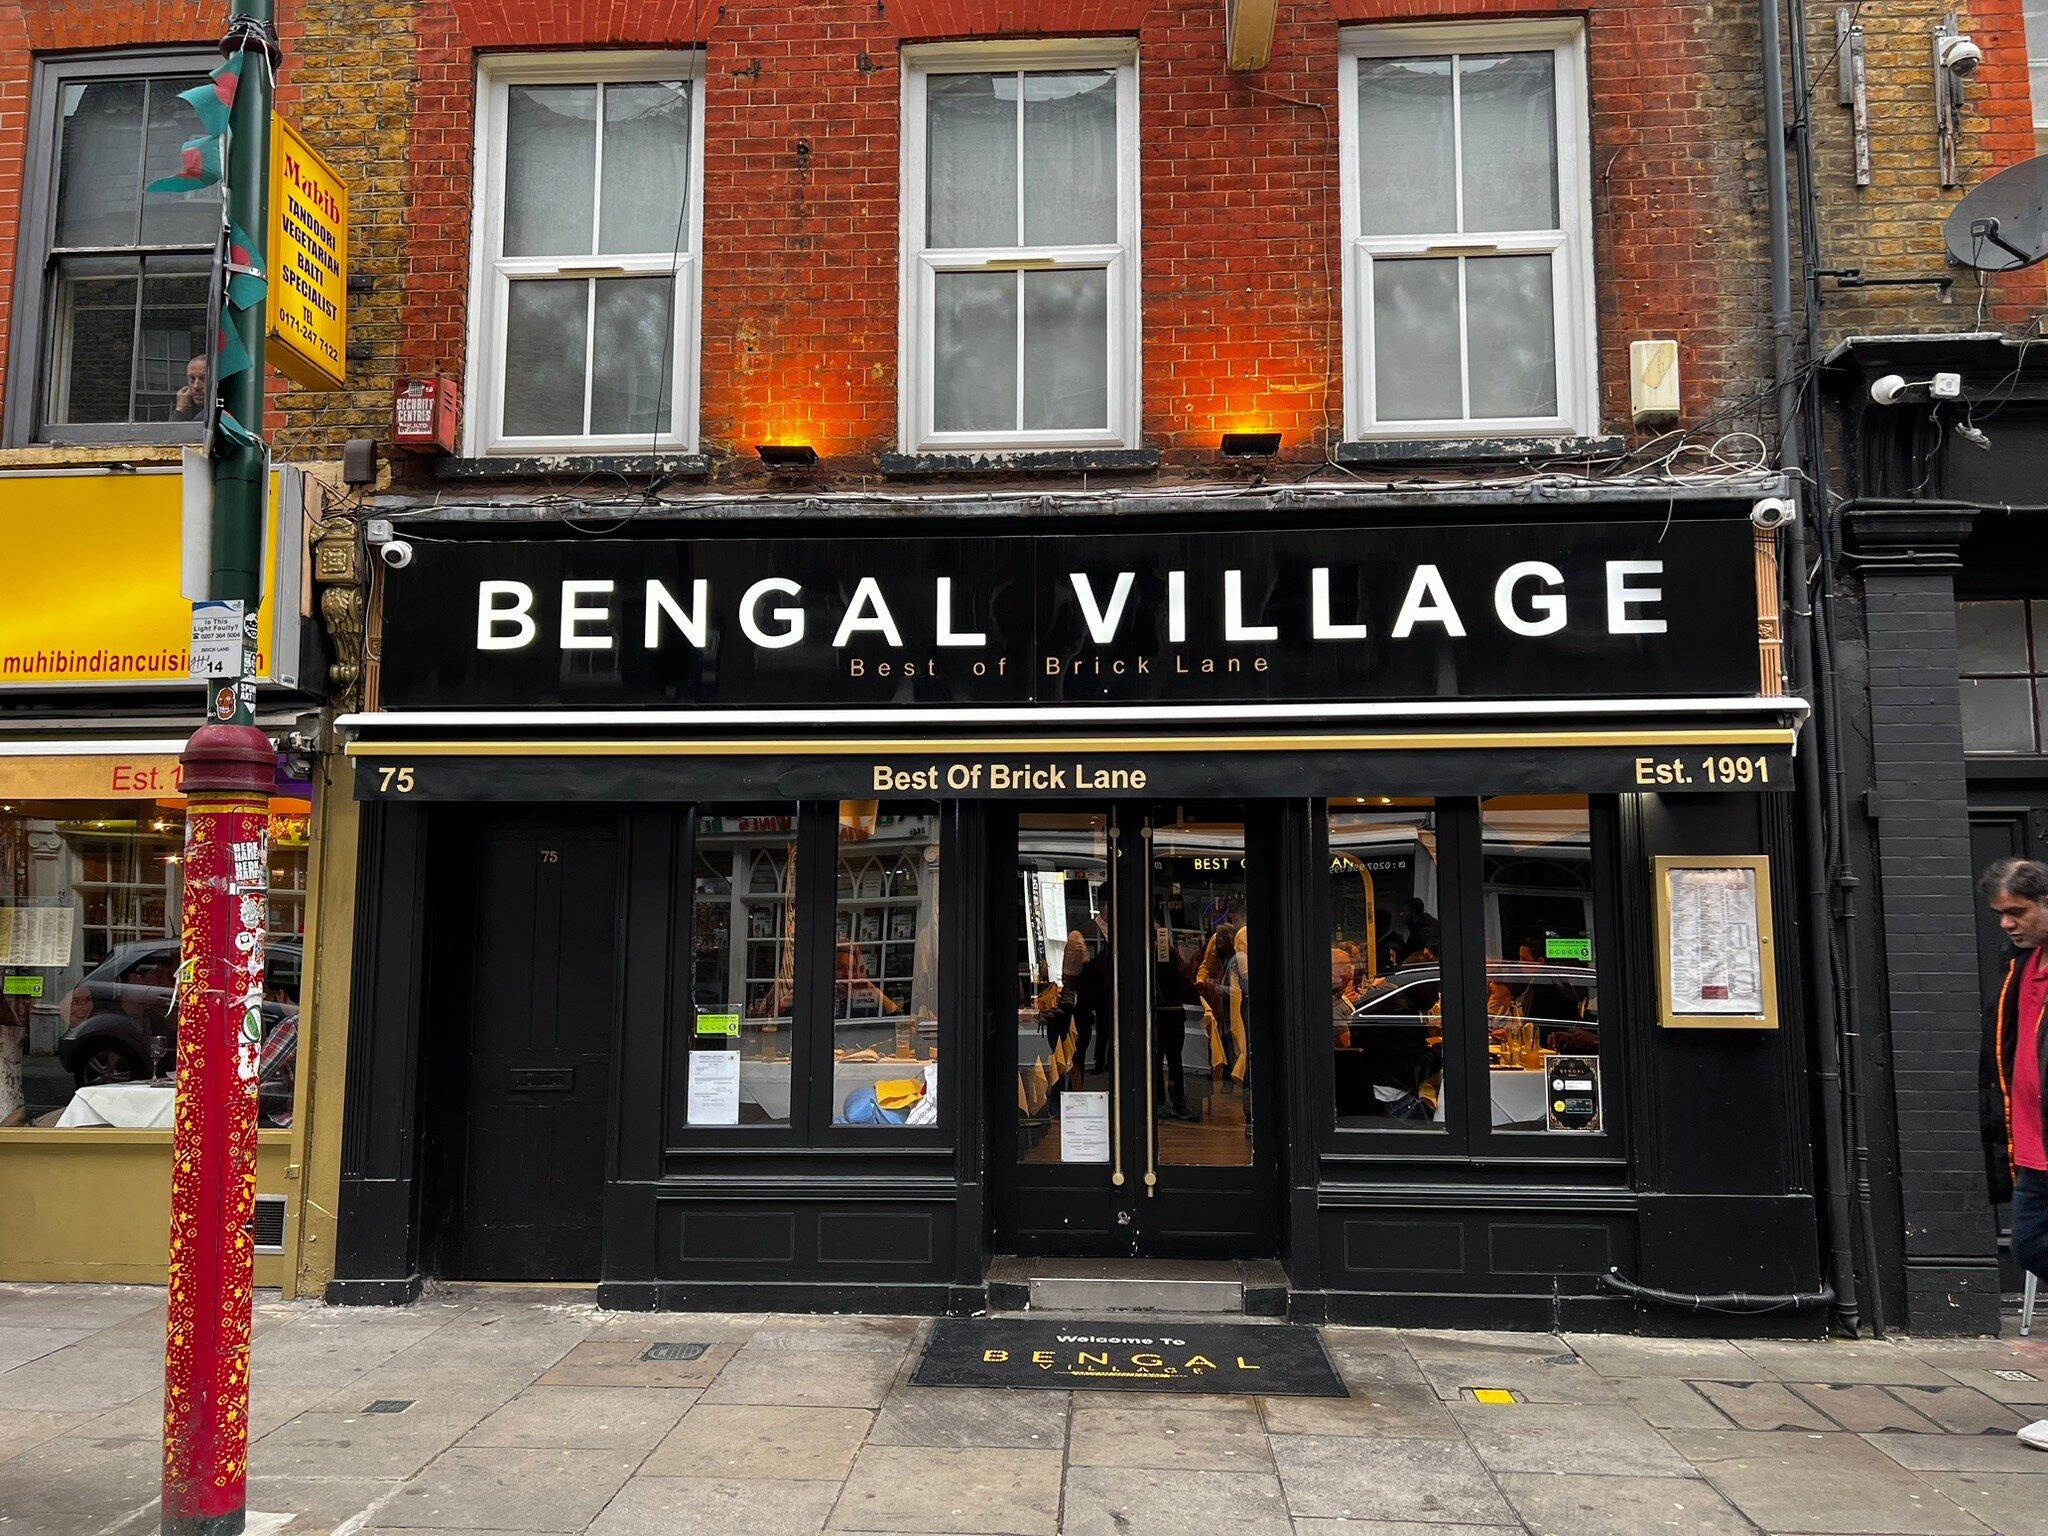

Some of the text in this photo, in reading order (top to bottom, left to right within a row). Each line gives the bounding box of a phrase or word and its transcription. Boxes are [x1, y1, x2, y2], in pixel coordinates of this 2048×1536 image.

[288, 195, 336, 252] TANDOORI
[282, 213, 340, 278] VEGETARIAN
[297, 251, 324, 287] BALTI
[282, 264, 338, 322] SPECIALIST
[302, 305, 314, 327] TEL
[279, 307, 339, 363] 0171-247 7122
[396, 398, 434, 410] SECURITY
[398, 410, 431, 422] CENTRES
[477, 561, 1668, 649] BENGAL VILLAGE
[193, 623, 239, 633] Light Faulty?
[207, 660, 223, 674] 14
[850, 654, 1270, 678] Best of Brick Lane
[112, 766, 164, 791] Est.
[378, 767, 415, 793] 75
[873, 763, 1147, 791] Best Of Brick Lane
[1635, 756, 1769, 785] Est. 1991
[541, 851, 558, 863] 75
[1194, 858, 1230, 870] BEST
[1158, 929, 1168, 960] PUSH
[1056, 1334, 1186, 1346] Welcome To
[982, 1349, 1261, 1370] BENGAL
